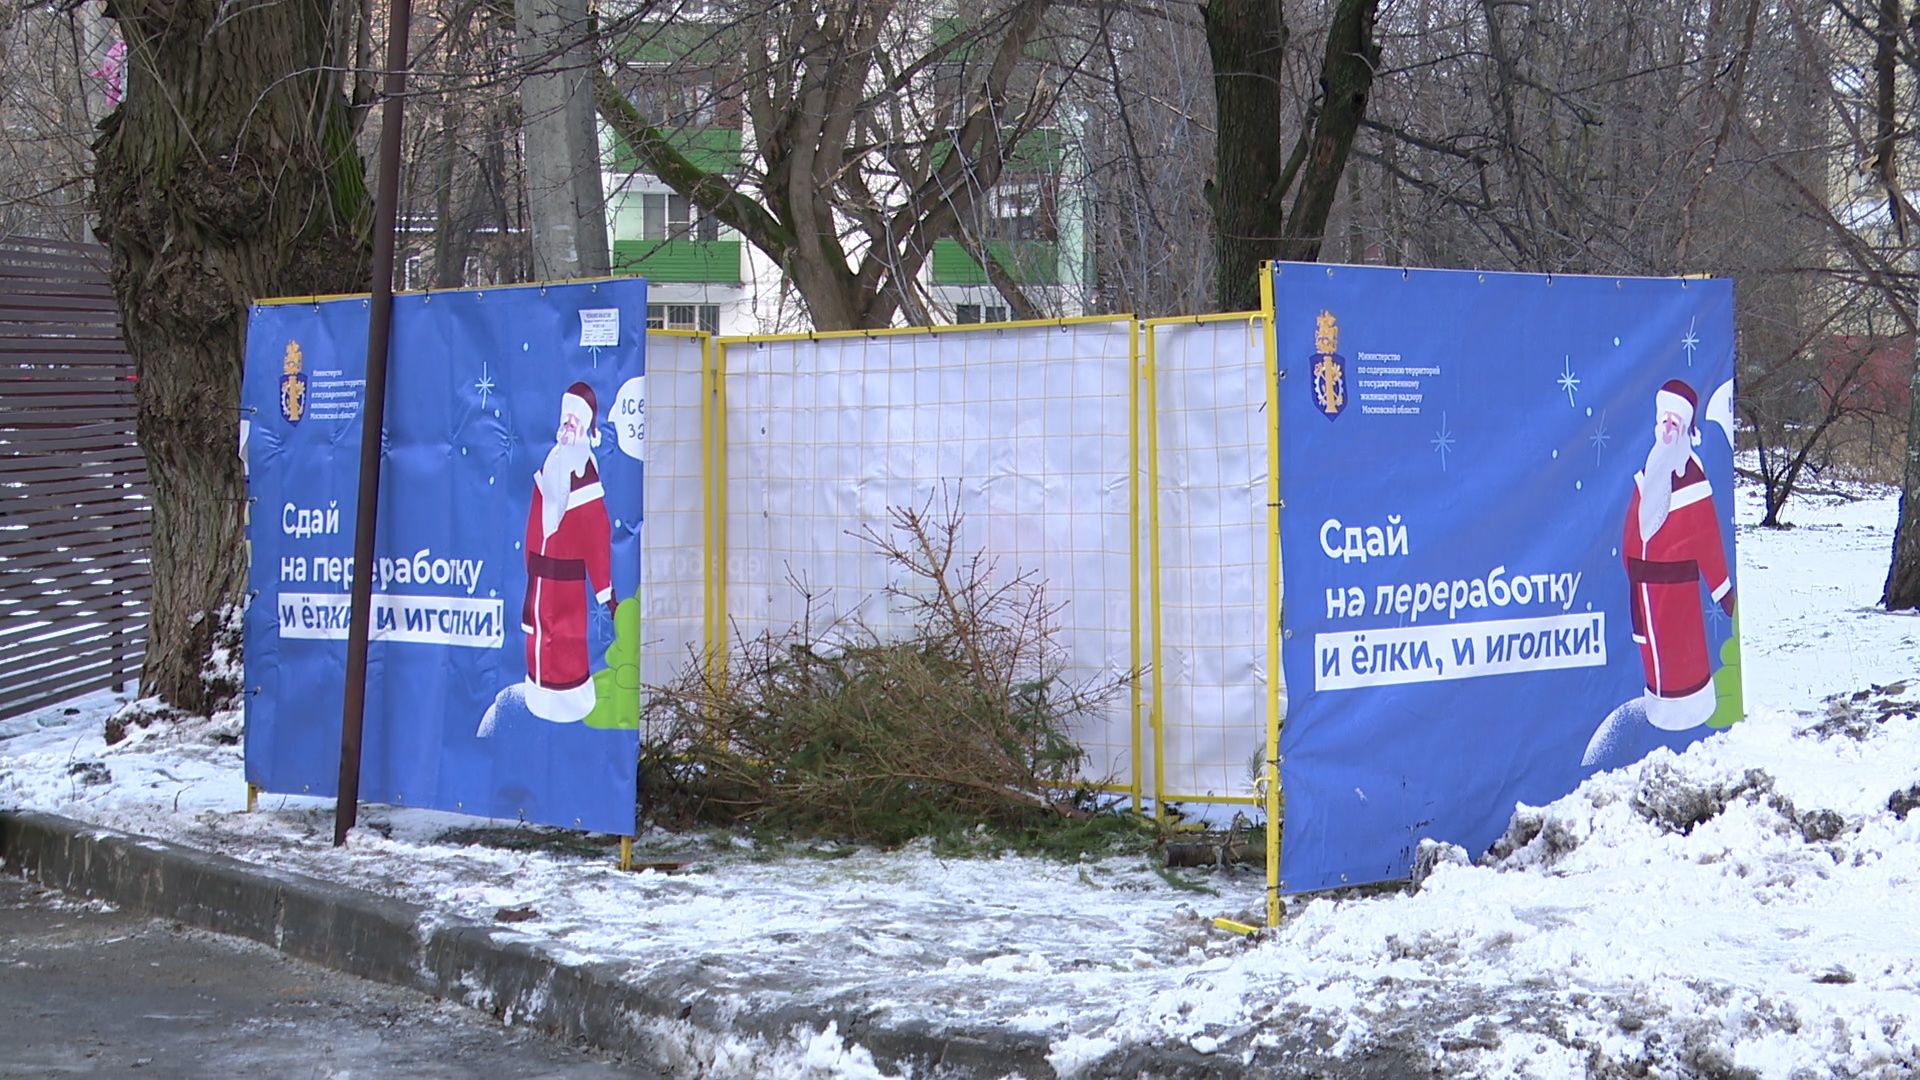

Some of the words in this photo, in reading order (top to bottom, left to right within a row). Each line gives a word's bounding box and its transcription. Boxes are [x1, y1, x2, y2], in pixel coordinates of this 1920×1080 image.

[281, 499, 340, 539] Сдай
[1318, 514, 1410, 564] Сдай
[280, 556, 307, 582] на
[1325, 586, 1366, 620] на
[1373, 565, 1583, 623] переработку
[281, 604, 297, 628] и
[376, 605, 397, 632] и
[404, 605, 503, 638] иголки!
[1321, 647, 1341, 678] и
[1350, 634, 1444, 676] ёлки,
[1452, 637, 1476, 667] и
[1485, 618, 1601, 665] иголки!
